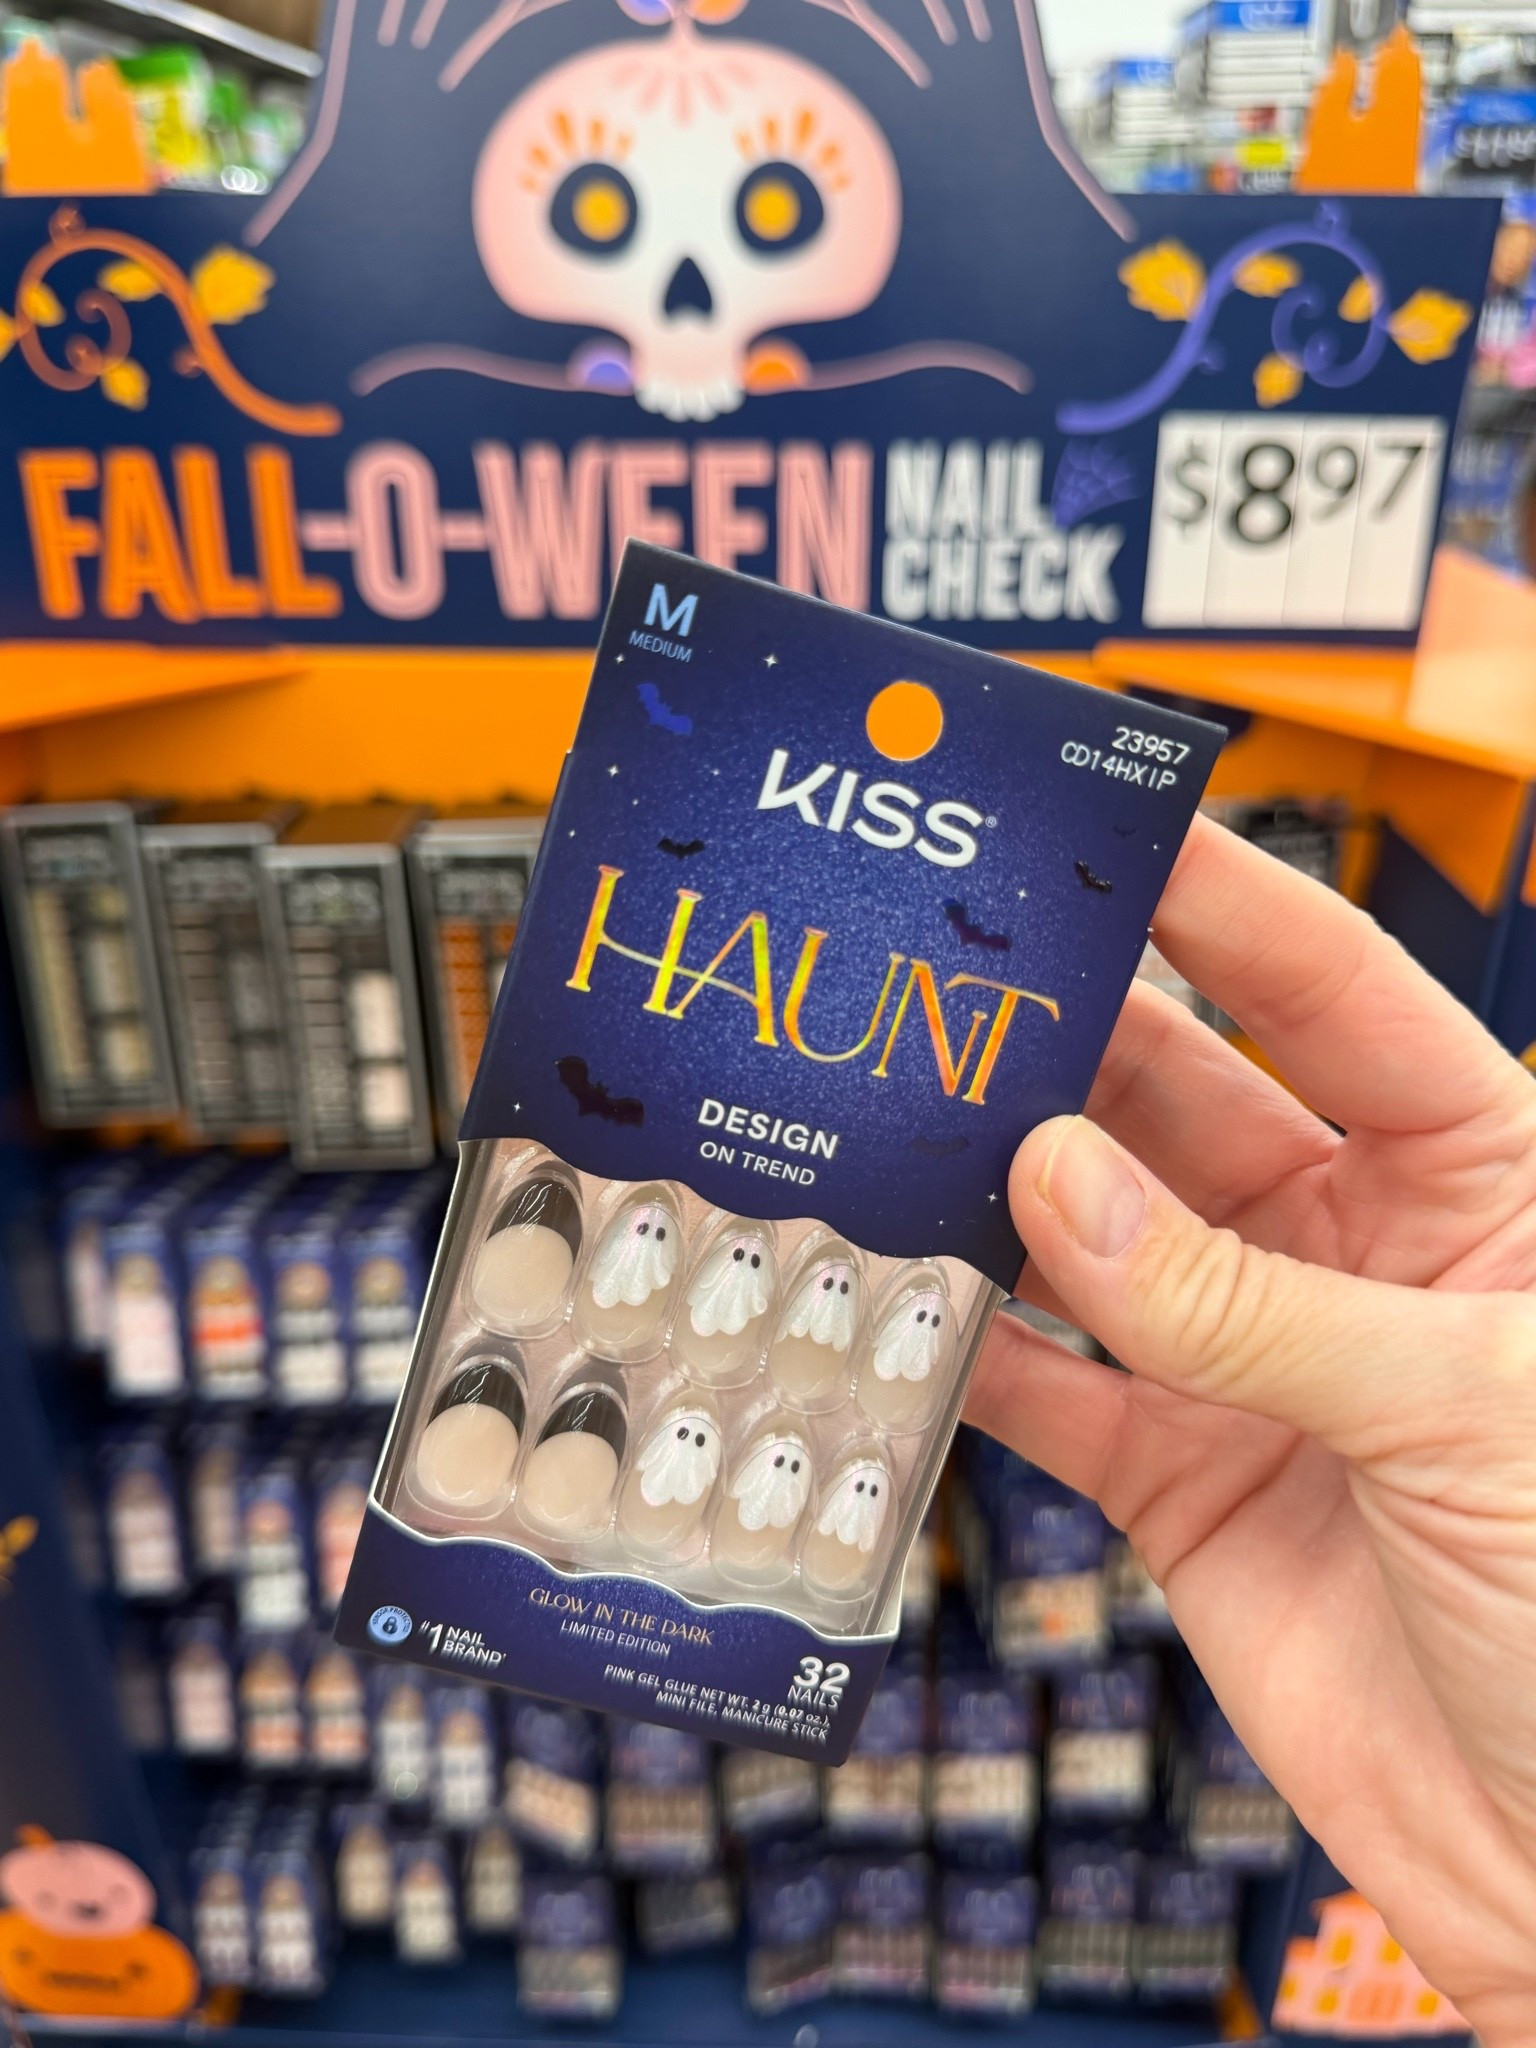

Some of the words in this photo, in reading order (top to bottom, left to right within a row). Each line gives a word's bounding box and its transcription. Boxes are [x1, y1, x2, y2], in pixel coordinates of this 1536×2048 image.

[887, 440, 1050, 537] NAIL
[882, 523, 1122, 623] CHECK
[643, 582, 699, 638] M
[628, 629, 693, 663] MEDIUM
[1111, 725, 1191, 765] 23957
[564, 863, 1061, 1106] HAUNT
[697, 1098, 839, 1160] DESIGN
[699, 1140, 736, 1166] ON
[740, 1150, 816, 1187] TREND
[446, 1625, 486, 1647] NAIL
[530, 1587, 593, 1614] GLOW
[594, 1603, 615, 1622] IN
[620, 1608, 658, 1631] THE
[660, 1618, 716, 1645] DARK
[560, 1618, 616, 1642] LIMITED
[616, 1632, 671, 1655] EDITION
[604, 1663, 636, 1681] PINK
[638, 1671, 660, 1687] GEL
[664, 1678, 698, 1696] GLUE
[699, 1686, 725, 1702] NET
[727, 1692, 749, 1708] WT.
[752, 1698, 760, 1711] 2
[773, 1703, 804, 1720] (0.07
[786, 1684, 841, 1709] NAILS
[792, 1655, 851, 1694] 32
[655, 1689, 687, 1707] MINI
[688, 1697, 718, 1715] FILE,
[721, 1704, 790, 1731] MANICURE
[791, 1720, 829, 1740] STICK
